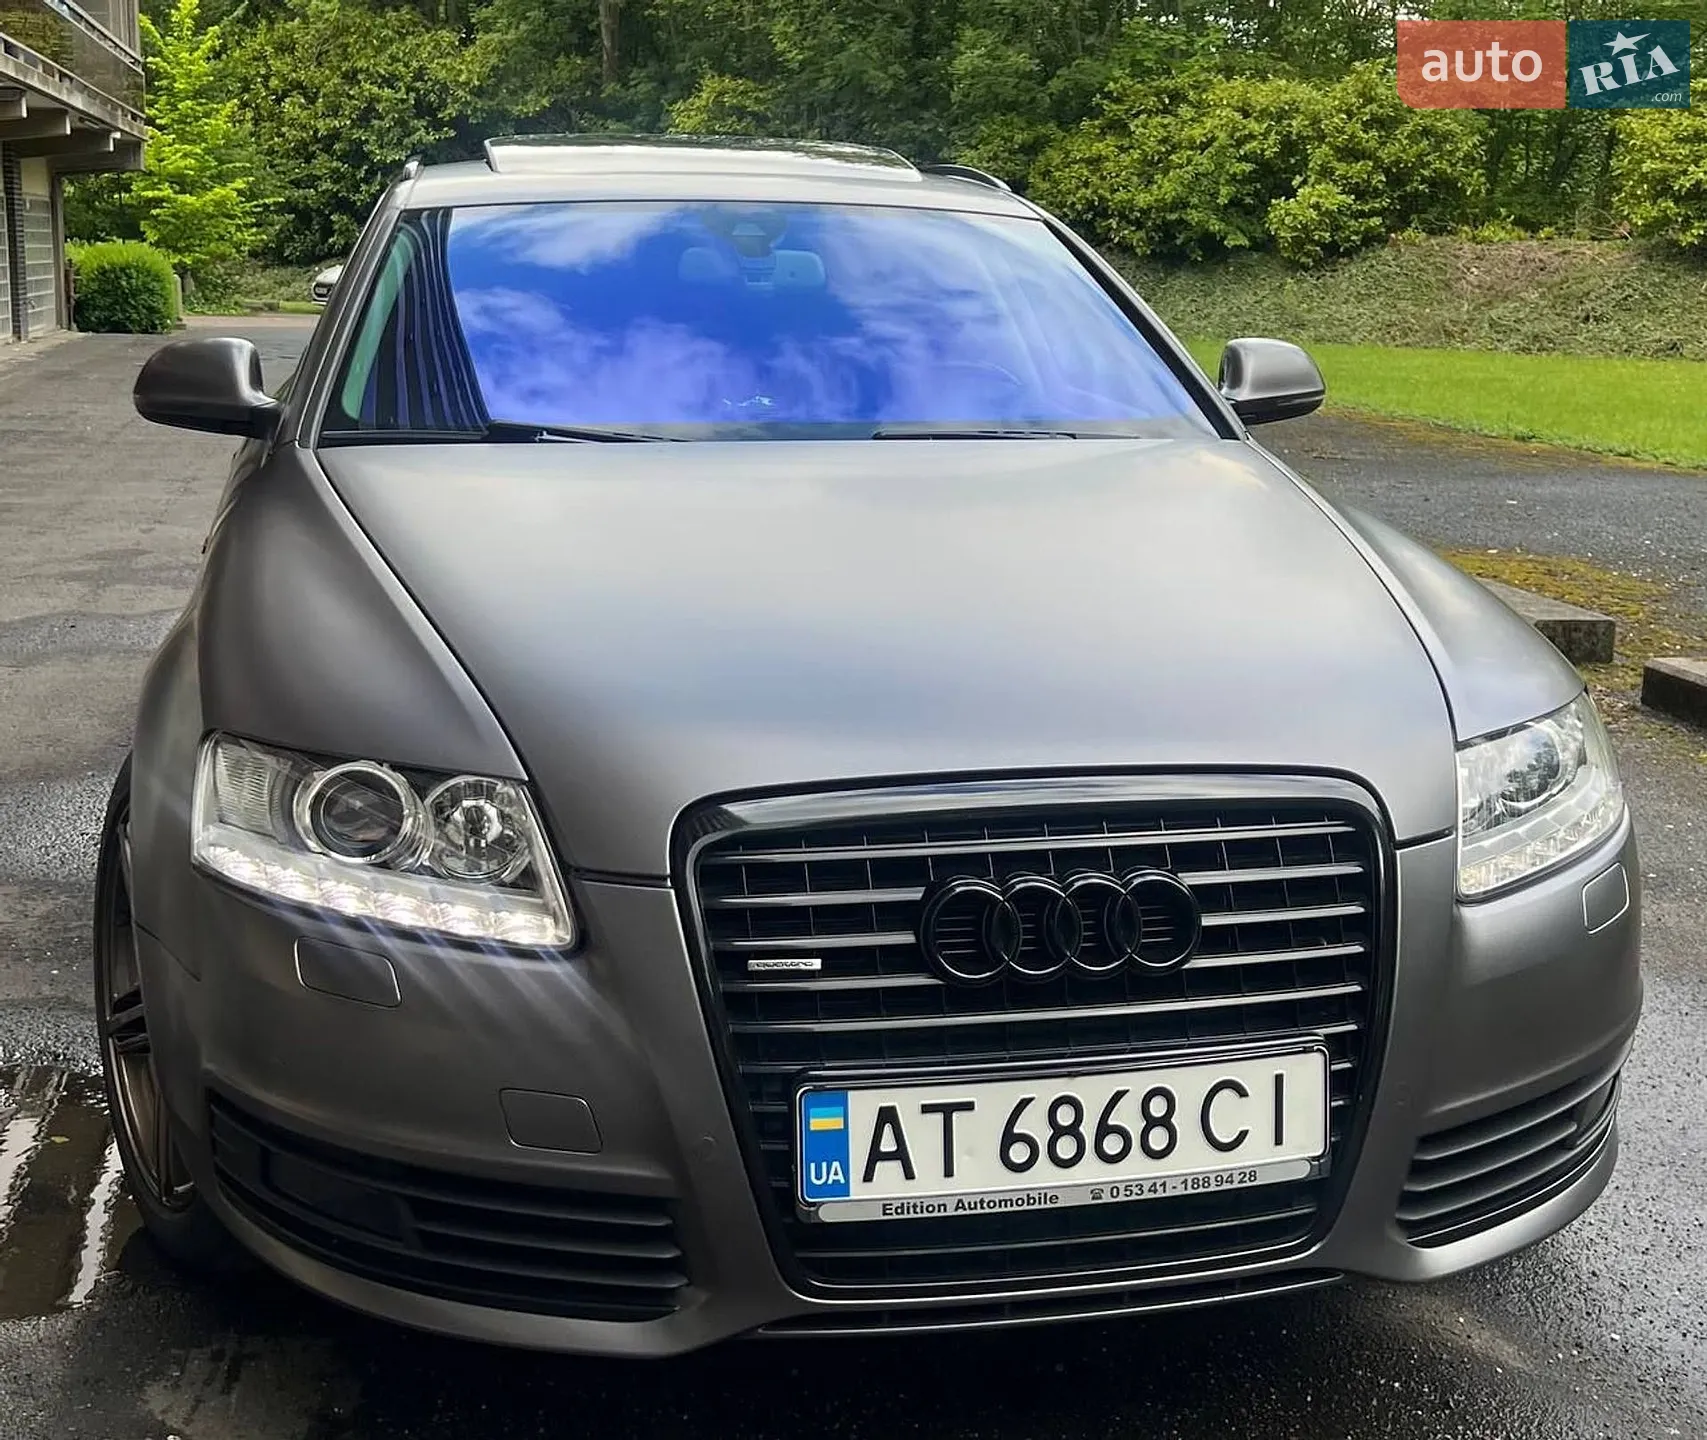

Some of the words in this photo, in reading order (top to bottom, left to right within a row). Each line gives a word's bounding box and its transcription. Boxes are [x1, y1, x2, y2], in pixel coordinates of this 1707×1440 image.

[862, 1100, 976, 1183] AT
[999, 1085, 1178, 1174] 6868
[1200, 1071, 1285, 1152] CI
[810, 1161, 845, 1185] UA
[881, 1201, 947, 1216] Edition
[954, 1192, 1059, 1212] Automobile
